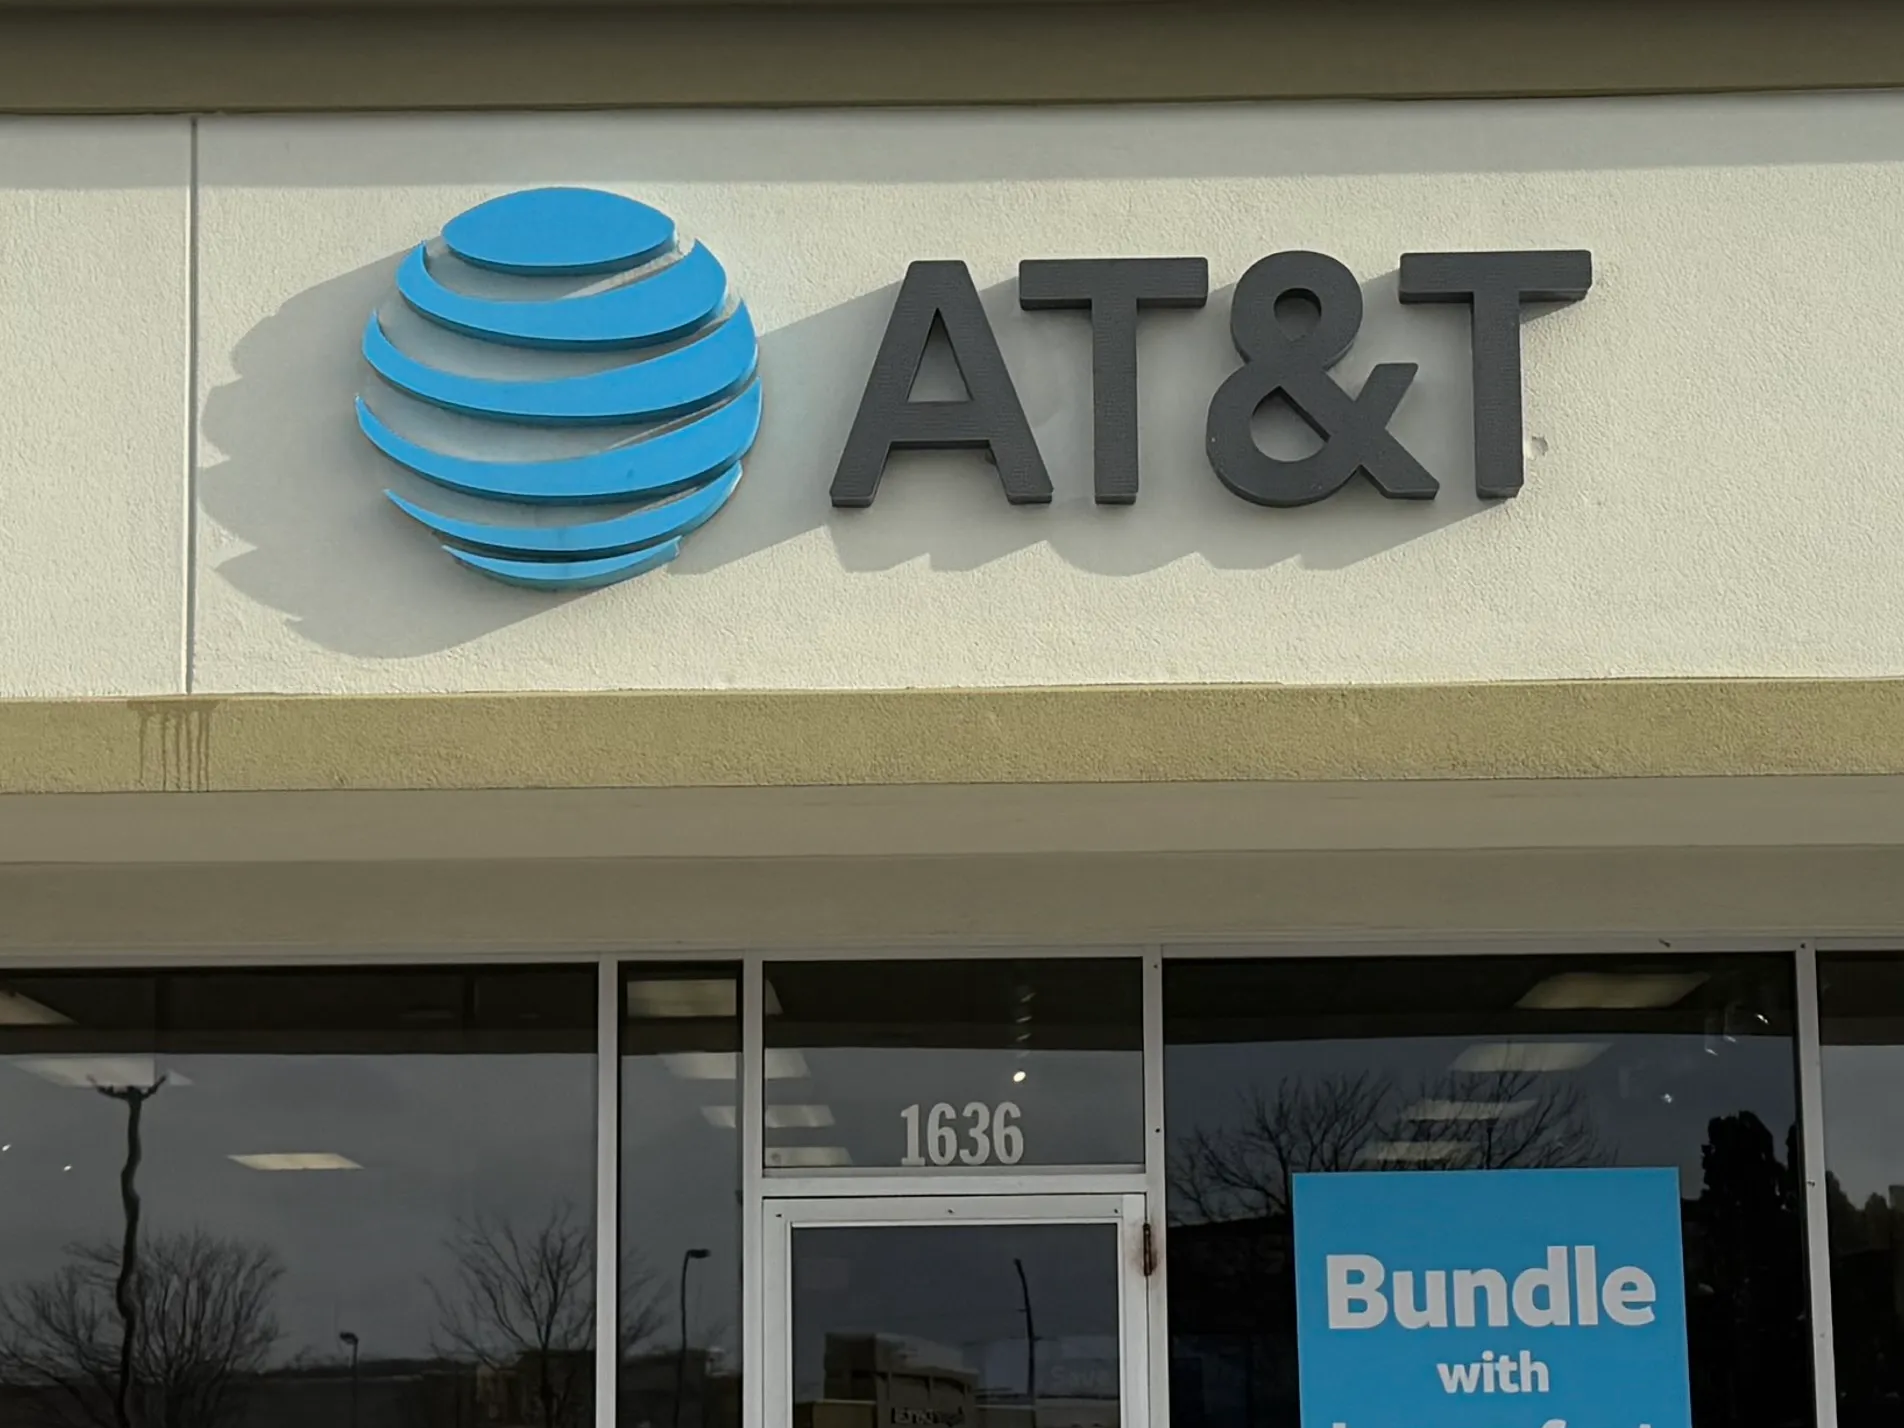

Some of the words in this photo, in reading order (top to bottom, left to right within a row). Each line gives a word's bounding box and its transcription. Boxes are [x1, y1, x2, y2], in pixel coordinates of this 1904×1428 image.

[828, 250, 1592, 507] AT&T
[900, 1101, 1024, 1166] 1636
[1325, 1244, 1657, 1330] Bundle
[1436, 1350, 1550, 1394] with
